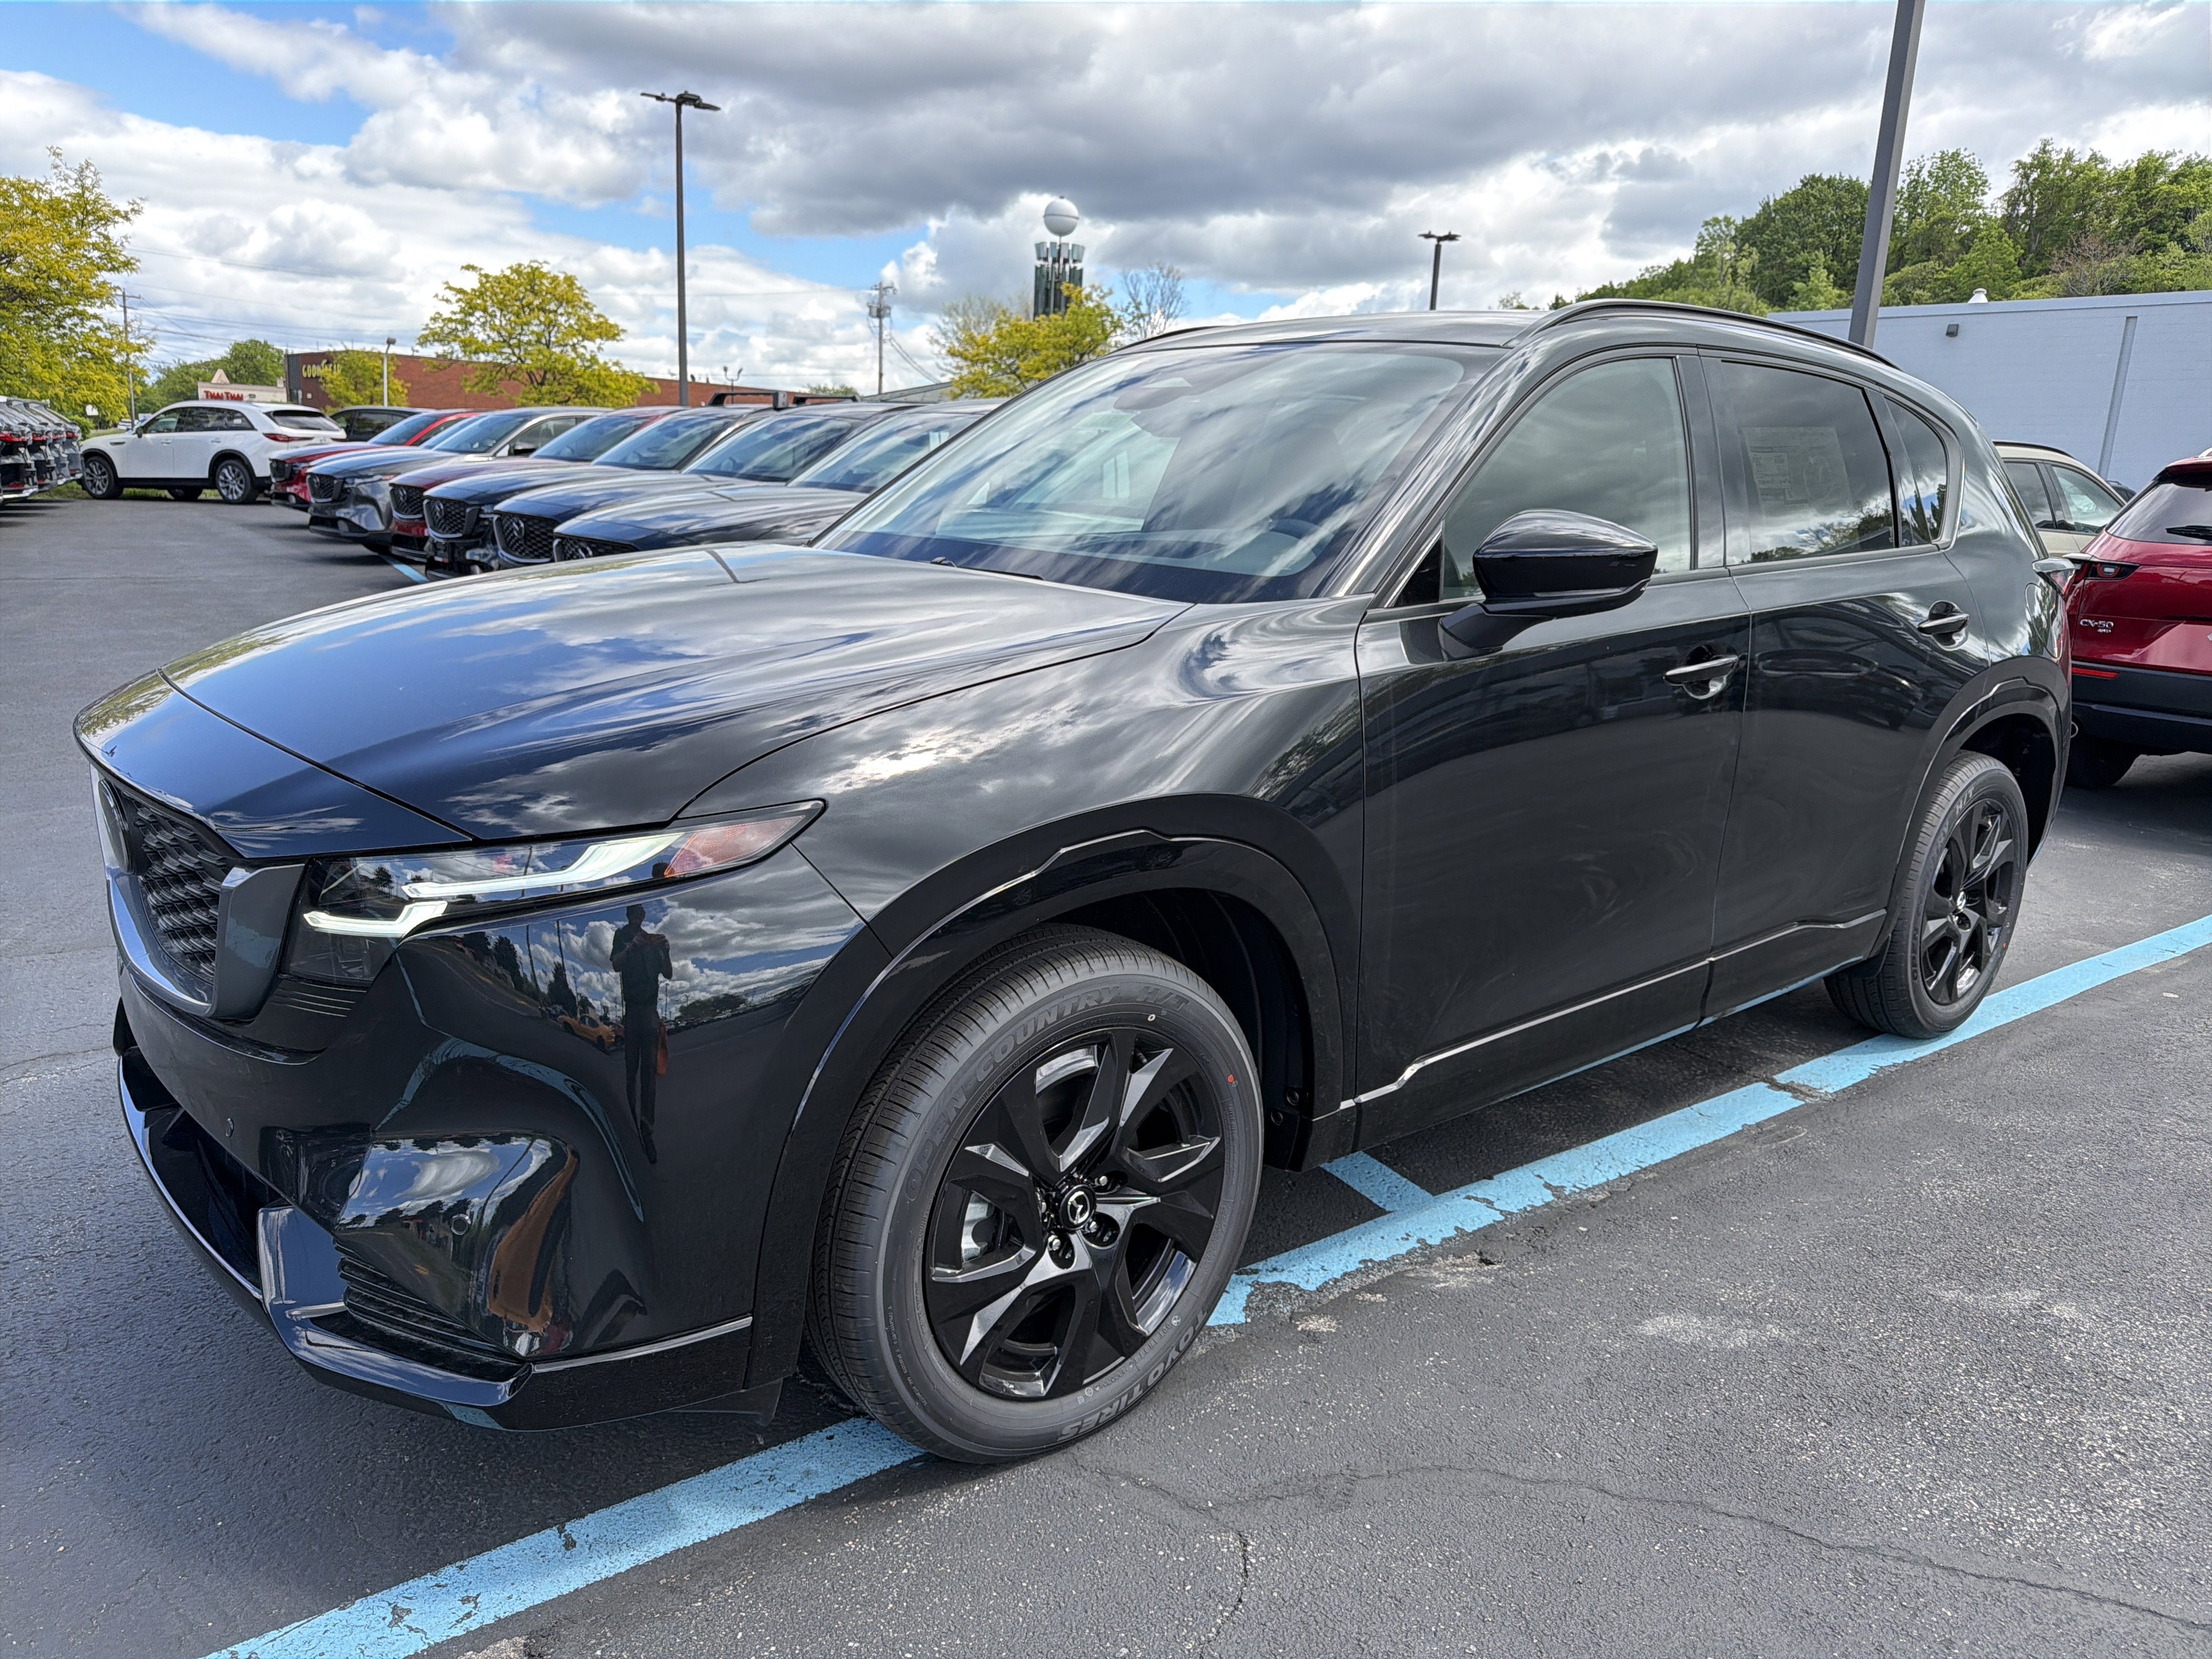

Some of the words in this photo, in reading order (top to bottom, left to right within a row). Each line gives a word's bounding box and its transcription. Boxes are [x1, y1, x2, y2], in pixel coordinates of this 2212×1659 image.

[2080, 619, 2114, 629] CX-50
[906, 1085, 967, 1201] OPEN
[976, 986, 1120, 1082] COUNTRY
[1136, 986, 1190, 1011] H/T
[1093, 1307, 1207, 1387] TOYO
[1057, 1383, 1143, 1442] TIRES
